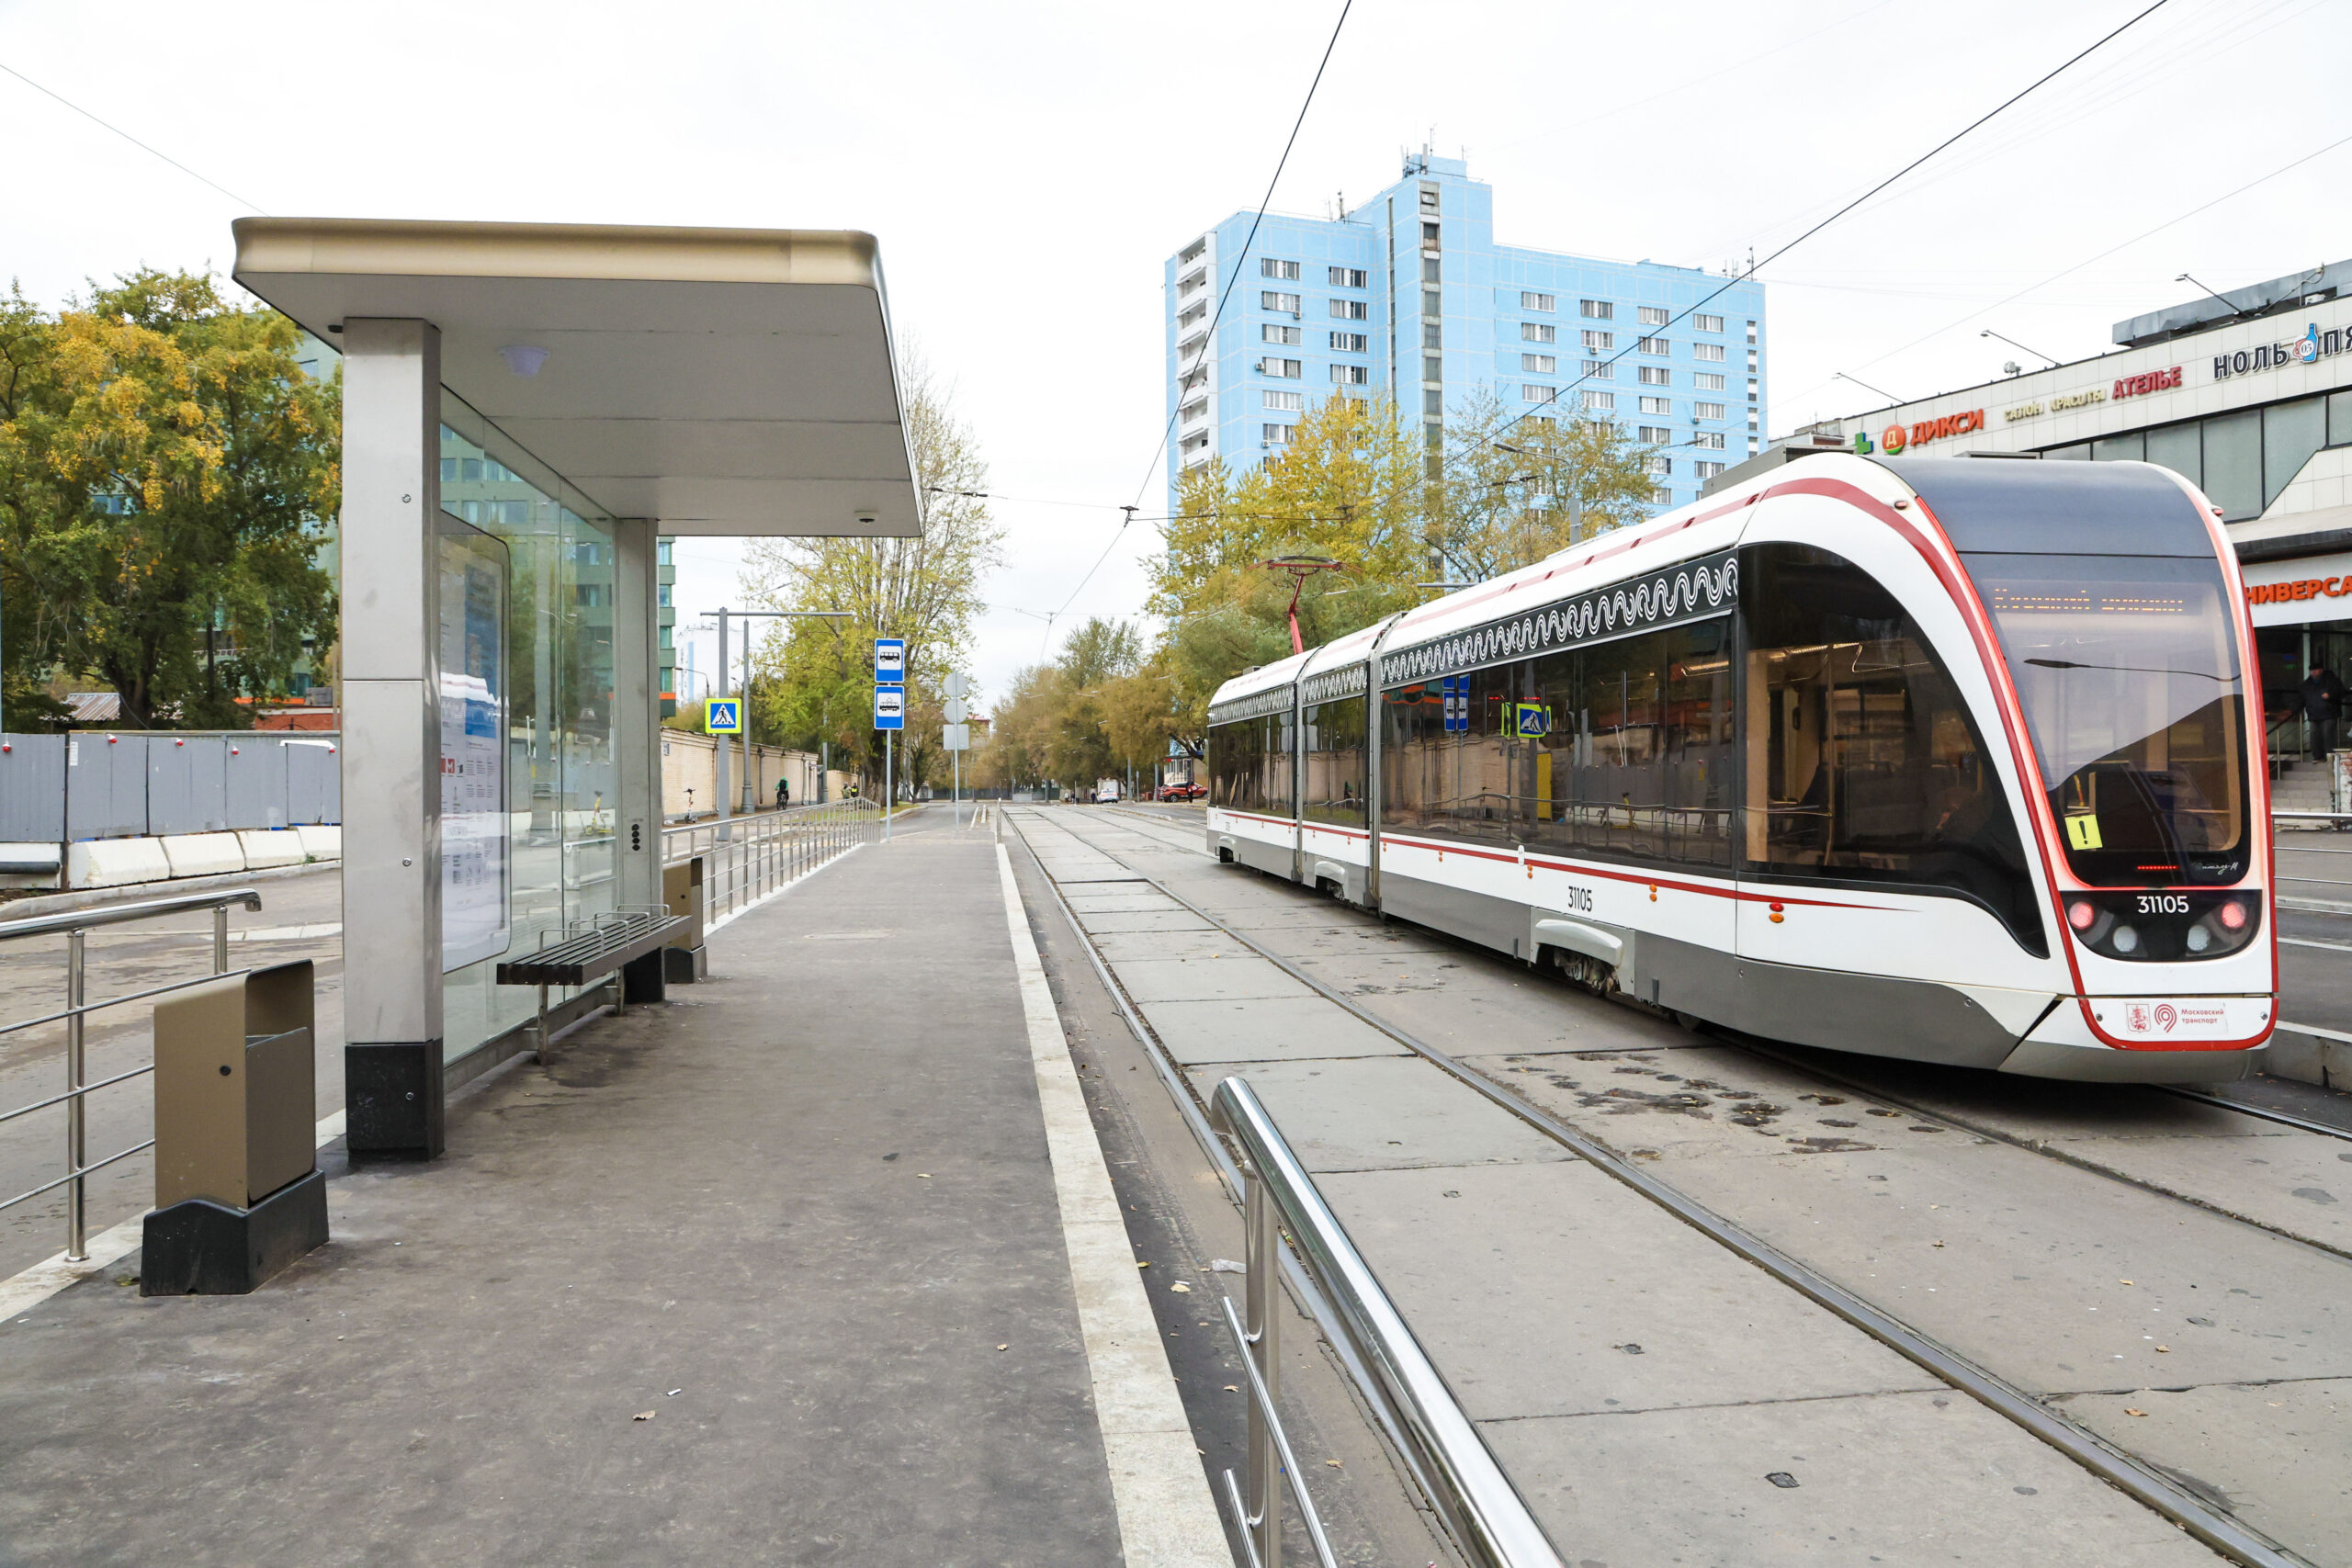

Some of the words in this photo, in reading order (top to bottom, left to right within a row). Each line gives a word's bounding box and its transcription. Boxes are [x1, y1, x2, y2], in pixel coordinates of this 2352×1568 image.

[2213, 342, 2289, 379] НОЛЬ
[2112, 366, 2182, 400] АТЕЛЬЕ
[2004, 401, 2044, 422] САЛОН
[2049, 389, 2107, 412] КРАСОТЫ
[1910, 409, 1984, 447] ДИКСИ
[1567, 886, 1593, 912] 31105
[2136, 895, 2189, 914] 31105
[2181, 1008, 2224, 1016] Московский
